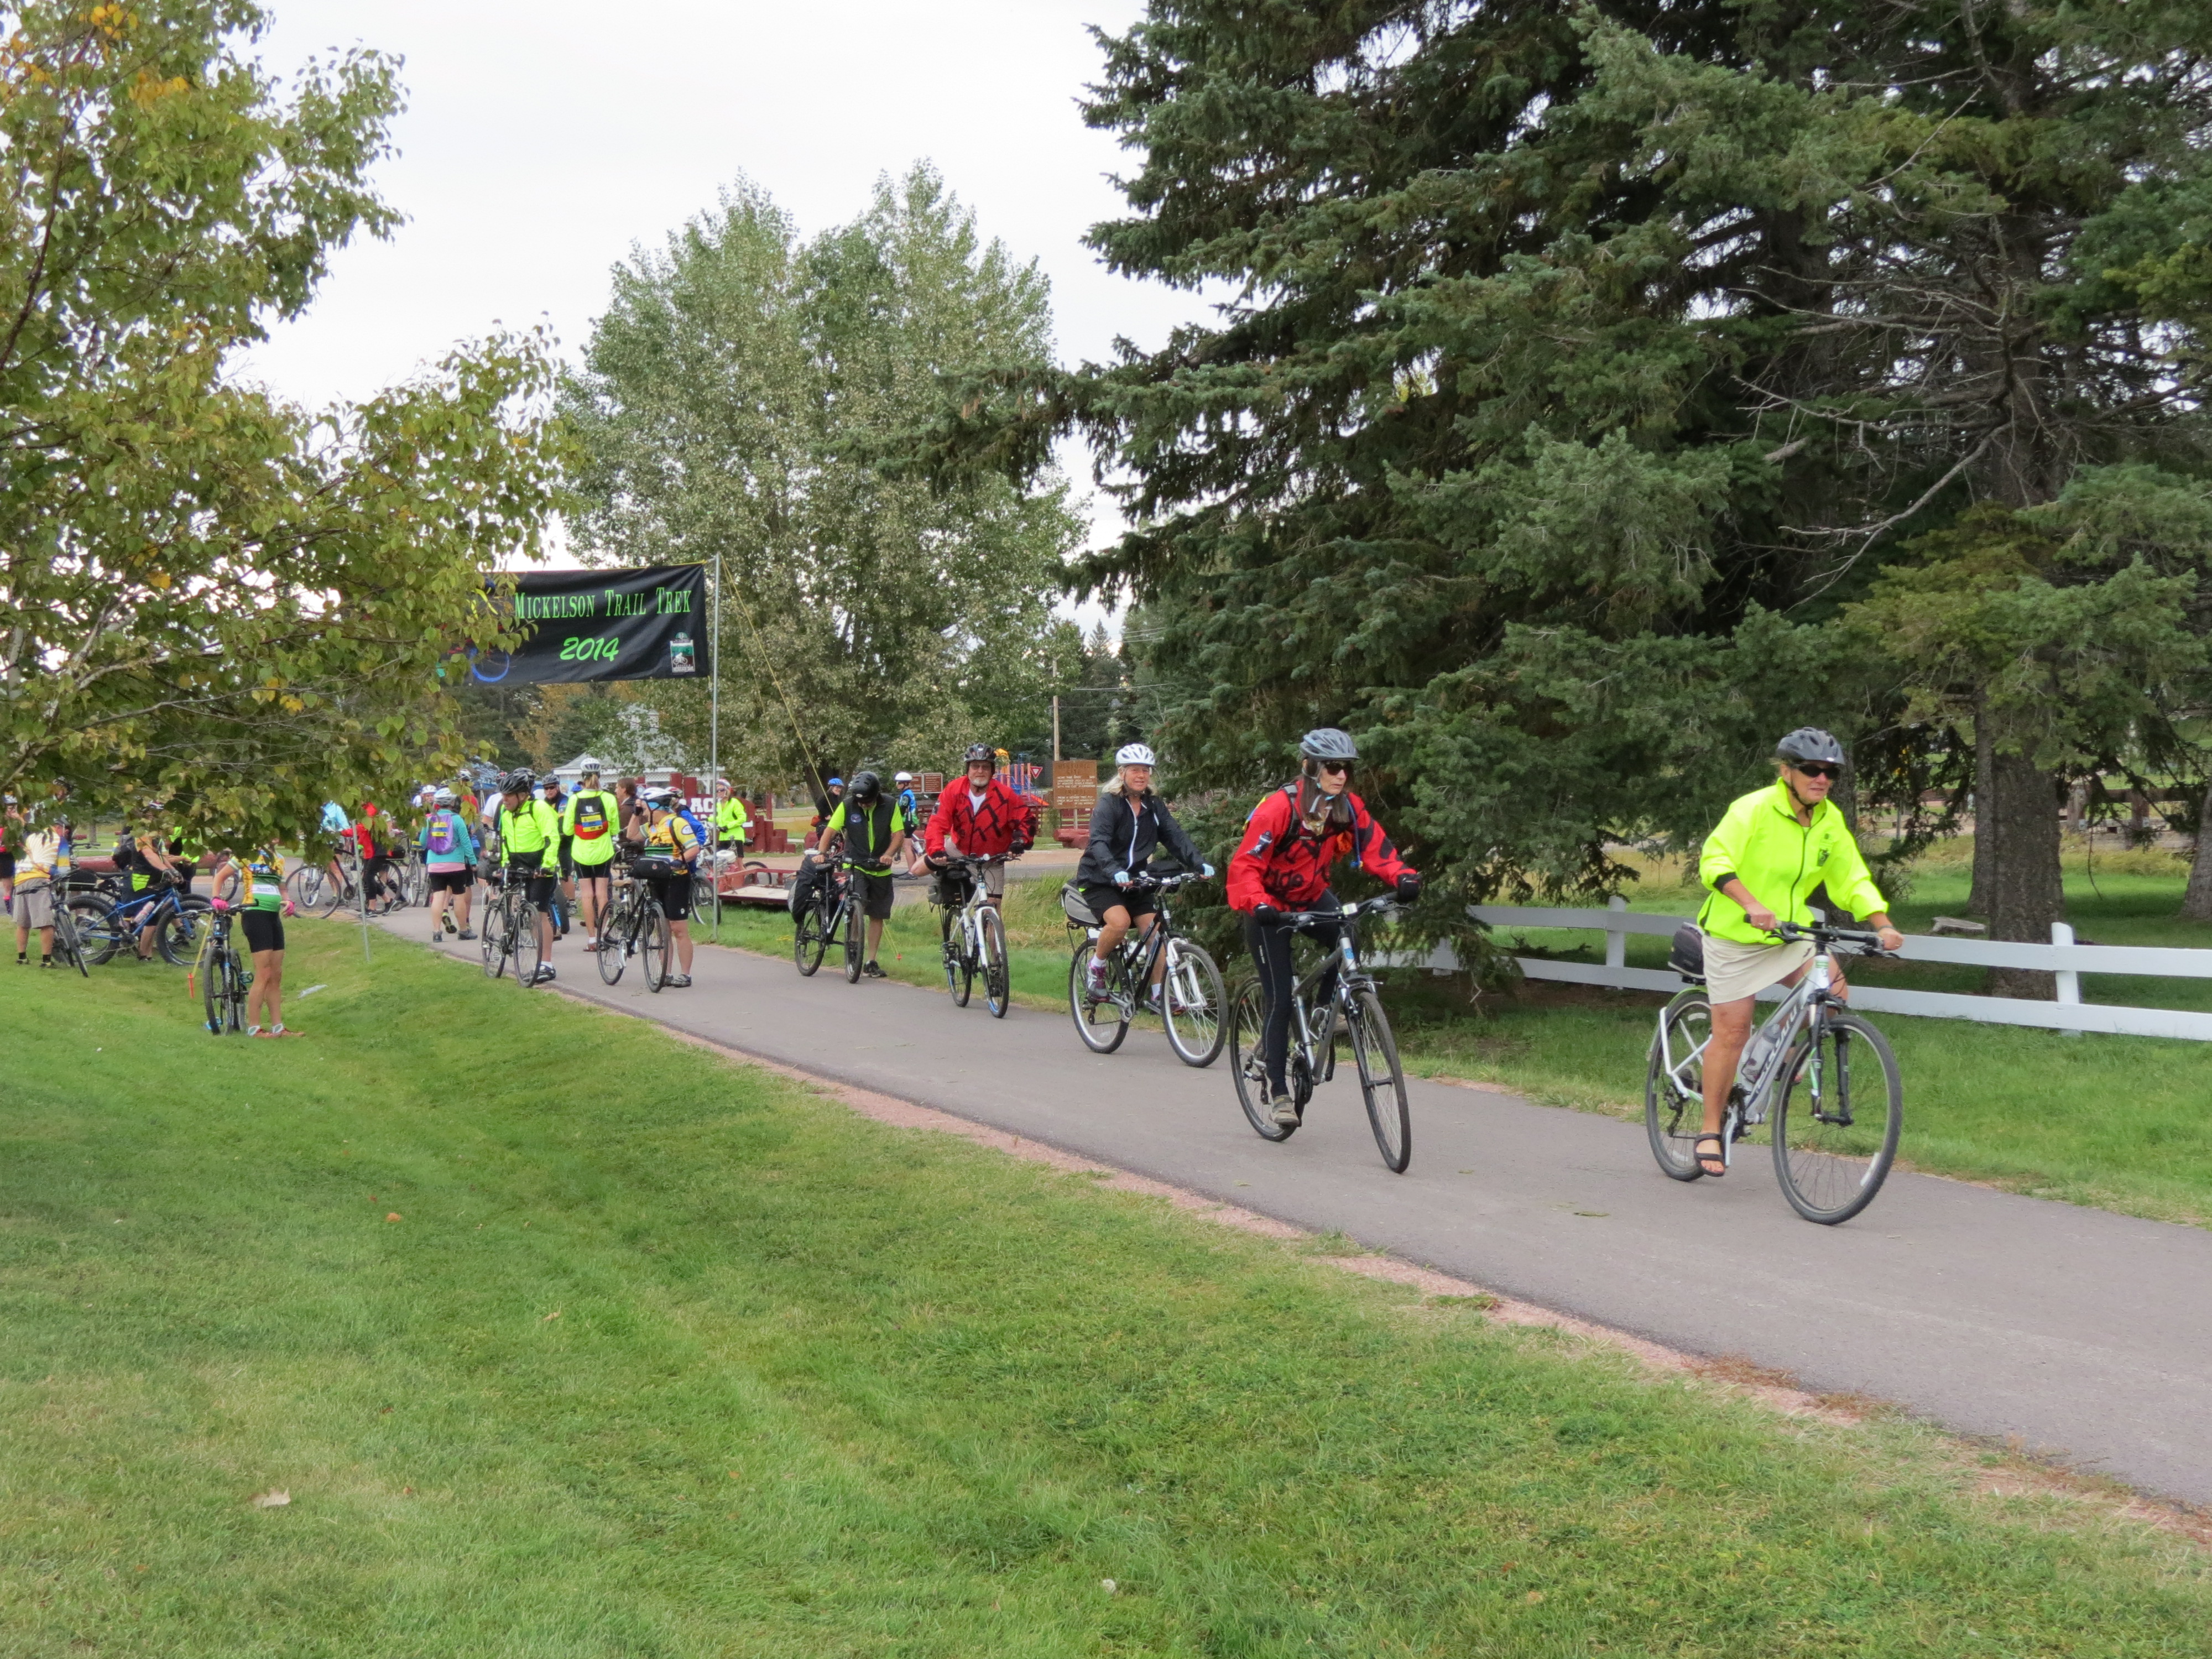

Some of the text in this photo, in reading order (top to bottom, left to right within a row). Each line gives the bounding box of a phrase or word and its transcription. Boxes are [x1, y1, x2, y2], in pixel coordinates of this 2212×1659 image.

[514, 587, 691, 619] MICKELSON TRAIL TREK
[560, 637, 619, 662] 2014
